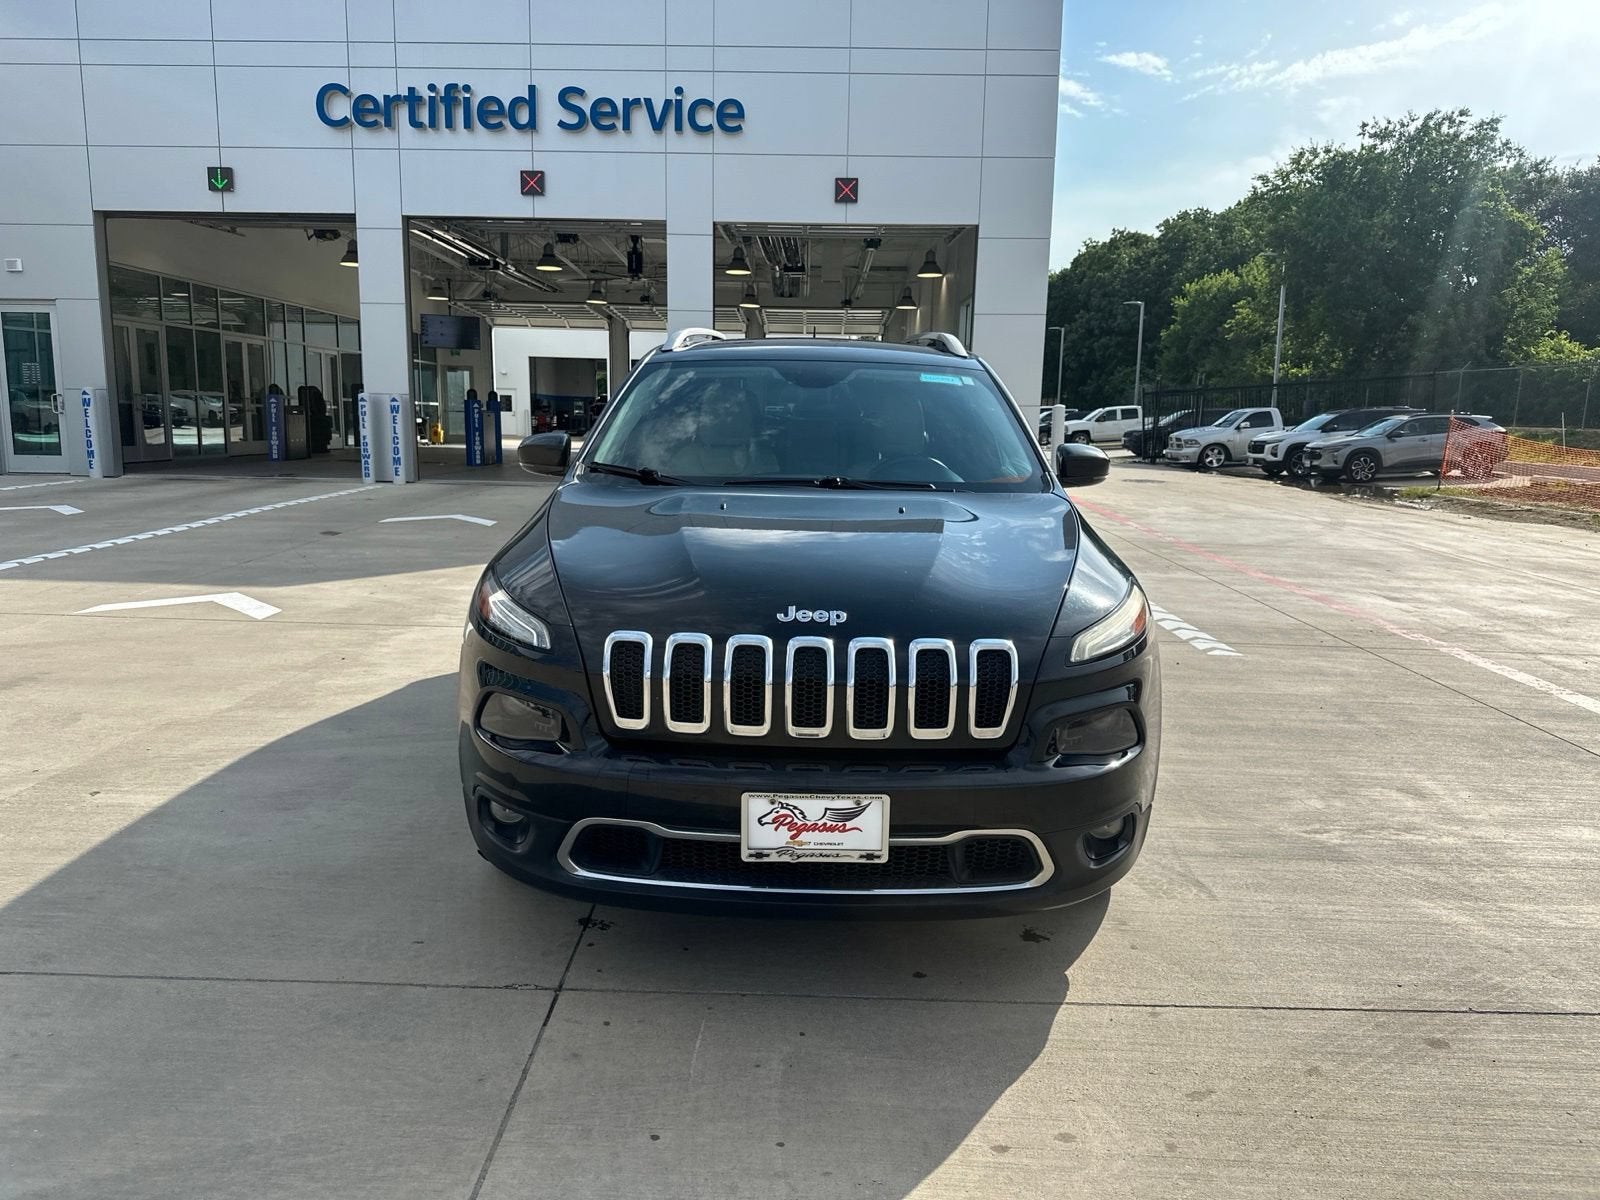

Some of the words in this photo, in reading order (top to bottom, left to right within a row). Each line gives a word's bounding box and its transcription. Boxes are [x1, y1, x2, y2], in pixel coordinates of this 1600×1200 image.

[316, 83, 537, 131] Certified
[557, 86, 745, 133] Service
[82, 397, 95, 470] WELCOME
[361, 435, 371, 478] FORWARD
[389, 404, 402, 477] WELCOME
[776, 605, 848, 626] Jeep
[772, 813, 863, 841] Pegasus
